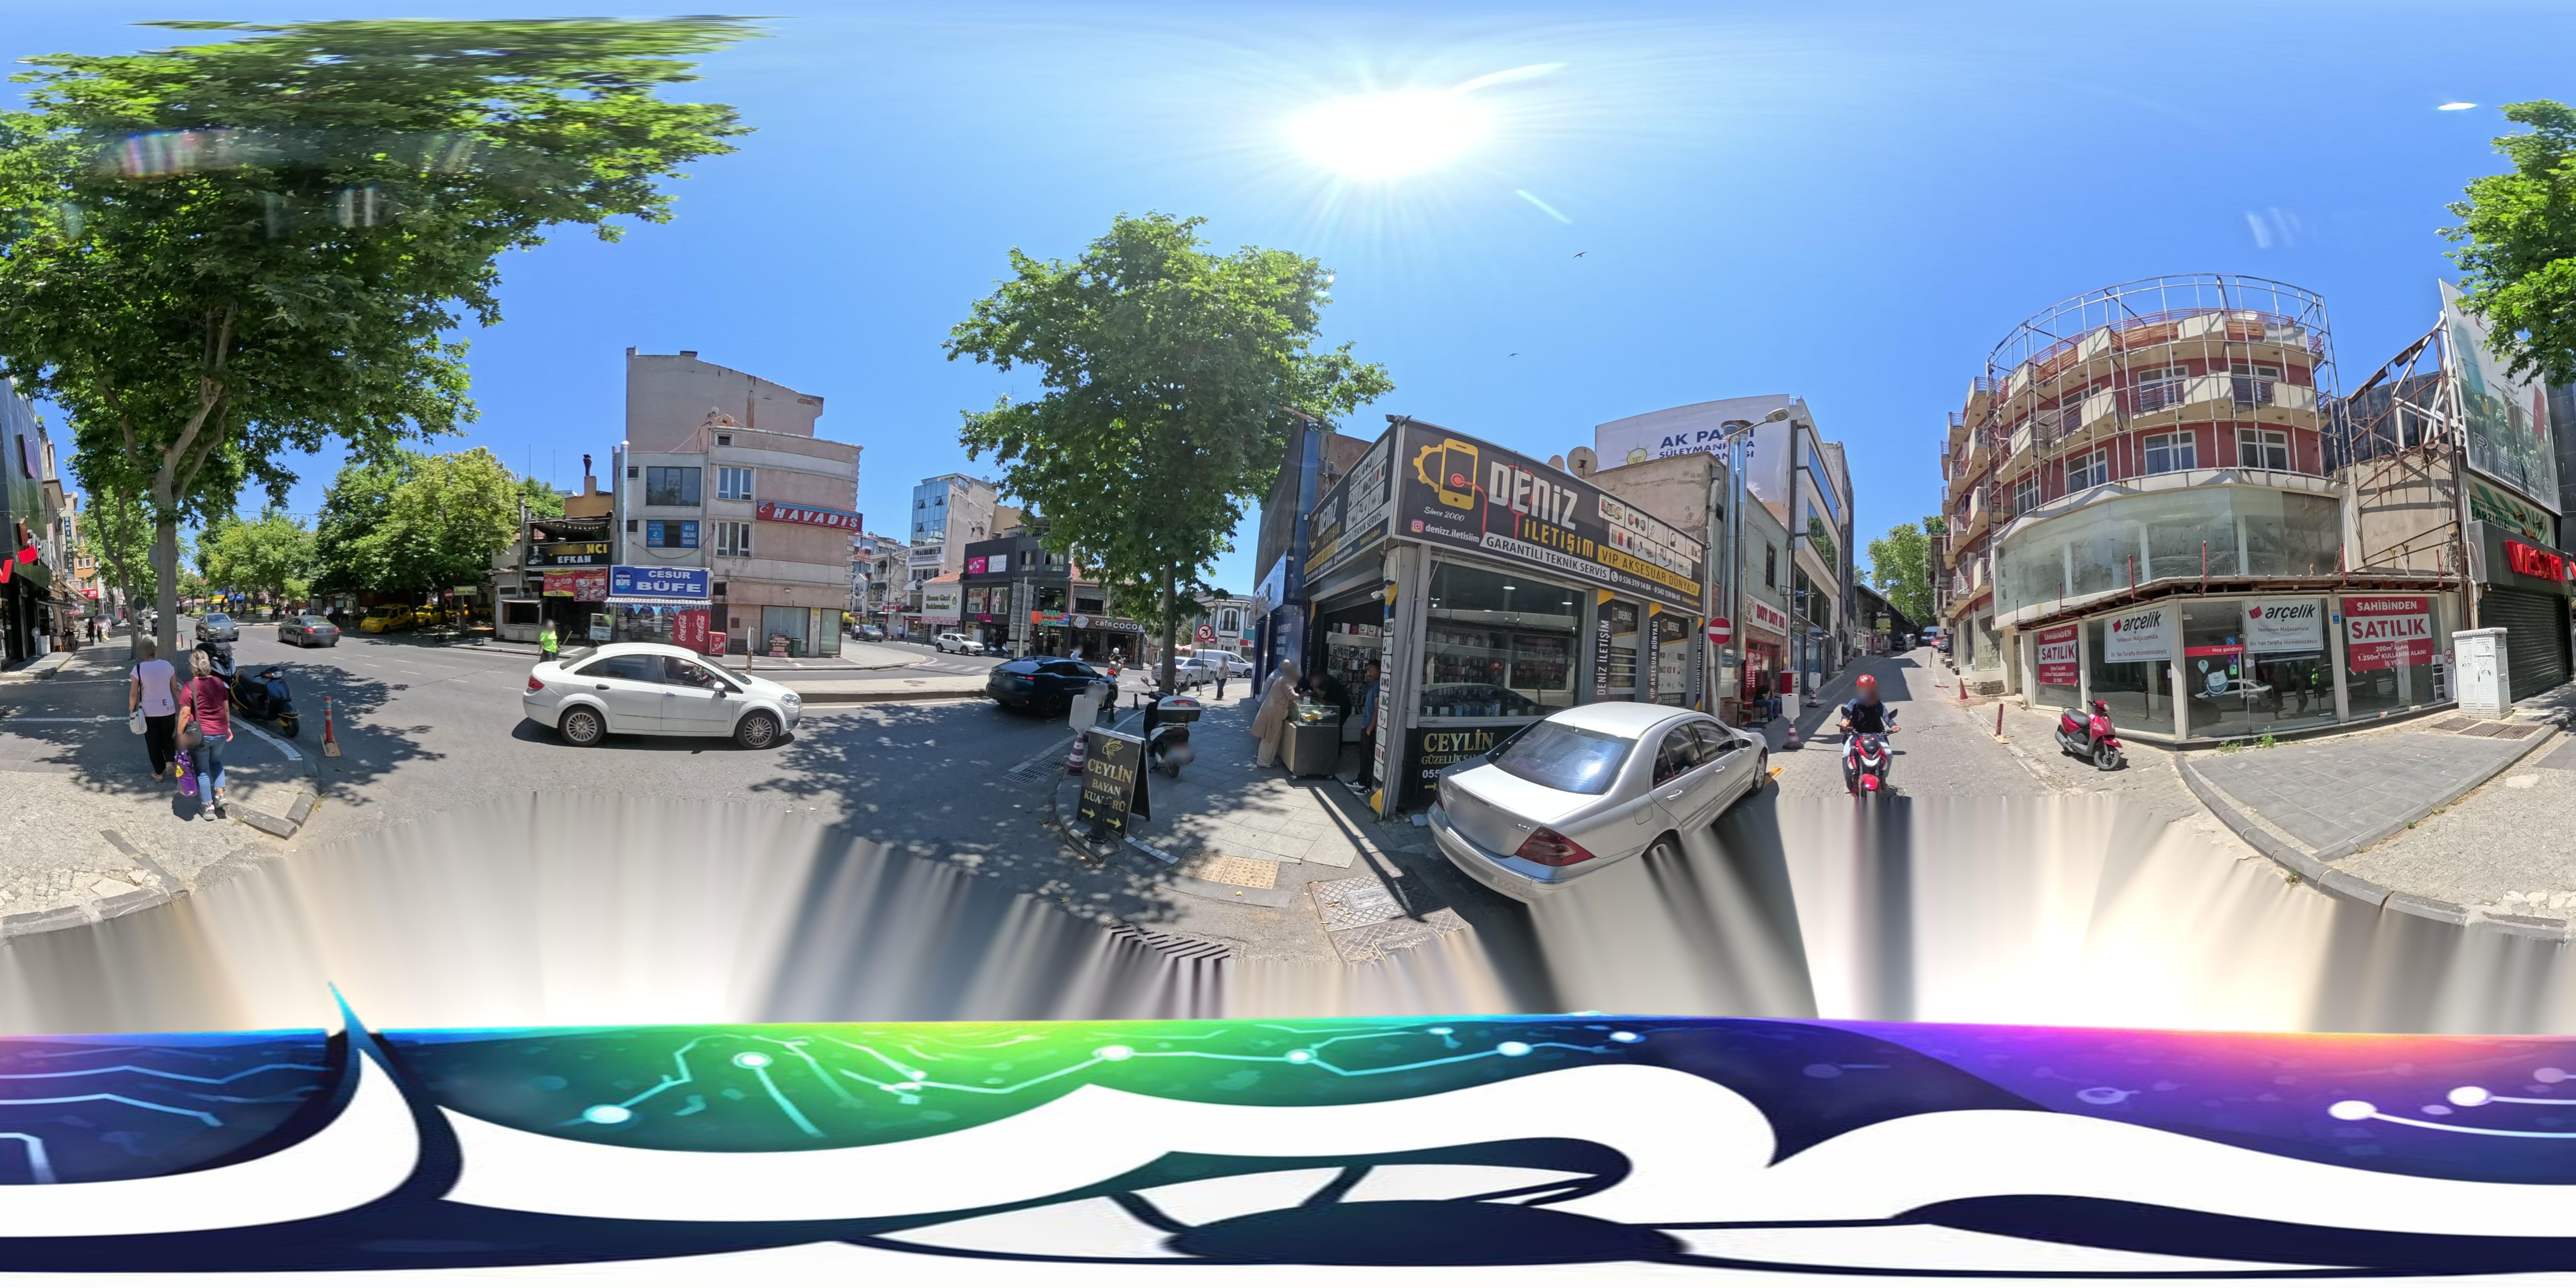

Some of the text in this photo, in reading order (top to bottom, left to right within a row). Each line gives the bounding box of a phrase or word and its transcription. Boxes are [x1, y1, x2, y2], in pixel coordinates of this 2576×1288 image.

[1660, 433, 1689, 449] AK
[1489, 462, 1577, 530] DENİZ
[773, 507, 858, 528] HAVADİS
[1366, 509, 1382, 530] SERVİS
[1424, 506, 1465, 522] Since 2000
[1426, 524, 1480, 543] denizz.iletisiim
[1524, 519, 1594, 558] İLETİŞİM
[557, 555, 592, 564] EFKAN
[1486, 536, 1607, 578] GARANTİLİ TEKNİK SERVİS
[648, 571, 691, 579] CESUR
[1602, 549, 1697, 594] VIP AKSESUAR DÜNYASI
[637, 581, 701, 593] BÜFE
[1757, 603, 1768, 622] DOY
[1769, 610, 1778, 626] DOY
[2265, 604, 2315, 622] arçelik
[2357, 599, 2417, 611] SAHİBİNDEN
[1113, 622, 1143, 630] COCOA
[2123, 610, 2161, 634] arçelik
[2351, 618, 2426, 639] SATILIK
[1597, 620, 1611, 662] İLETİŞİM
[1650, 621, 1658, 649] DÜNYASI
[2044, 629, 2072, 641] SAHİBİNDEN
[2133, 633, 2158, 642] Mağazamızla
[2041, 644, 2075, 661] SATILIK
[2381, 651, 2409, 659] KULLANIM
[1650, 651, 1658, 686] AKSESUAR
[2384, 657, 2403, 668] İŞ YERİ
[1596, 666, 1607, 695] DENİZ
[1650, 688, 1658, 699] VIP
[1424, 729, 1495, 752] CEYLİN
[1421, 753, 1461, 765] GÜZELLİK
[1087, 758, 1133, 784] CEYLİN
[1092, 778, 1121, 797] BAYAN
[1083, 789, 1127, 812] KUARÜ
